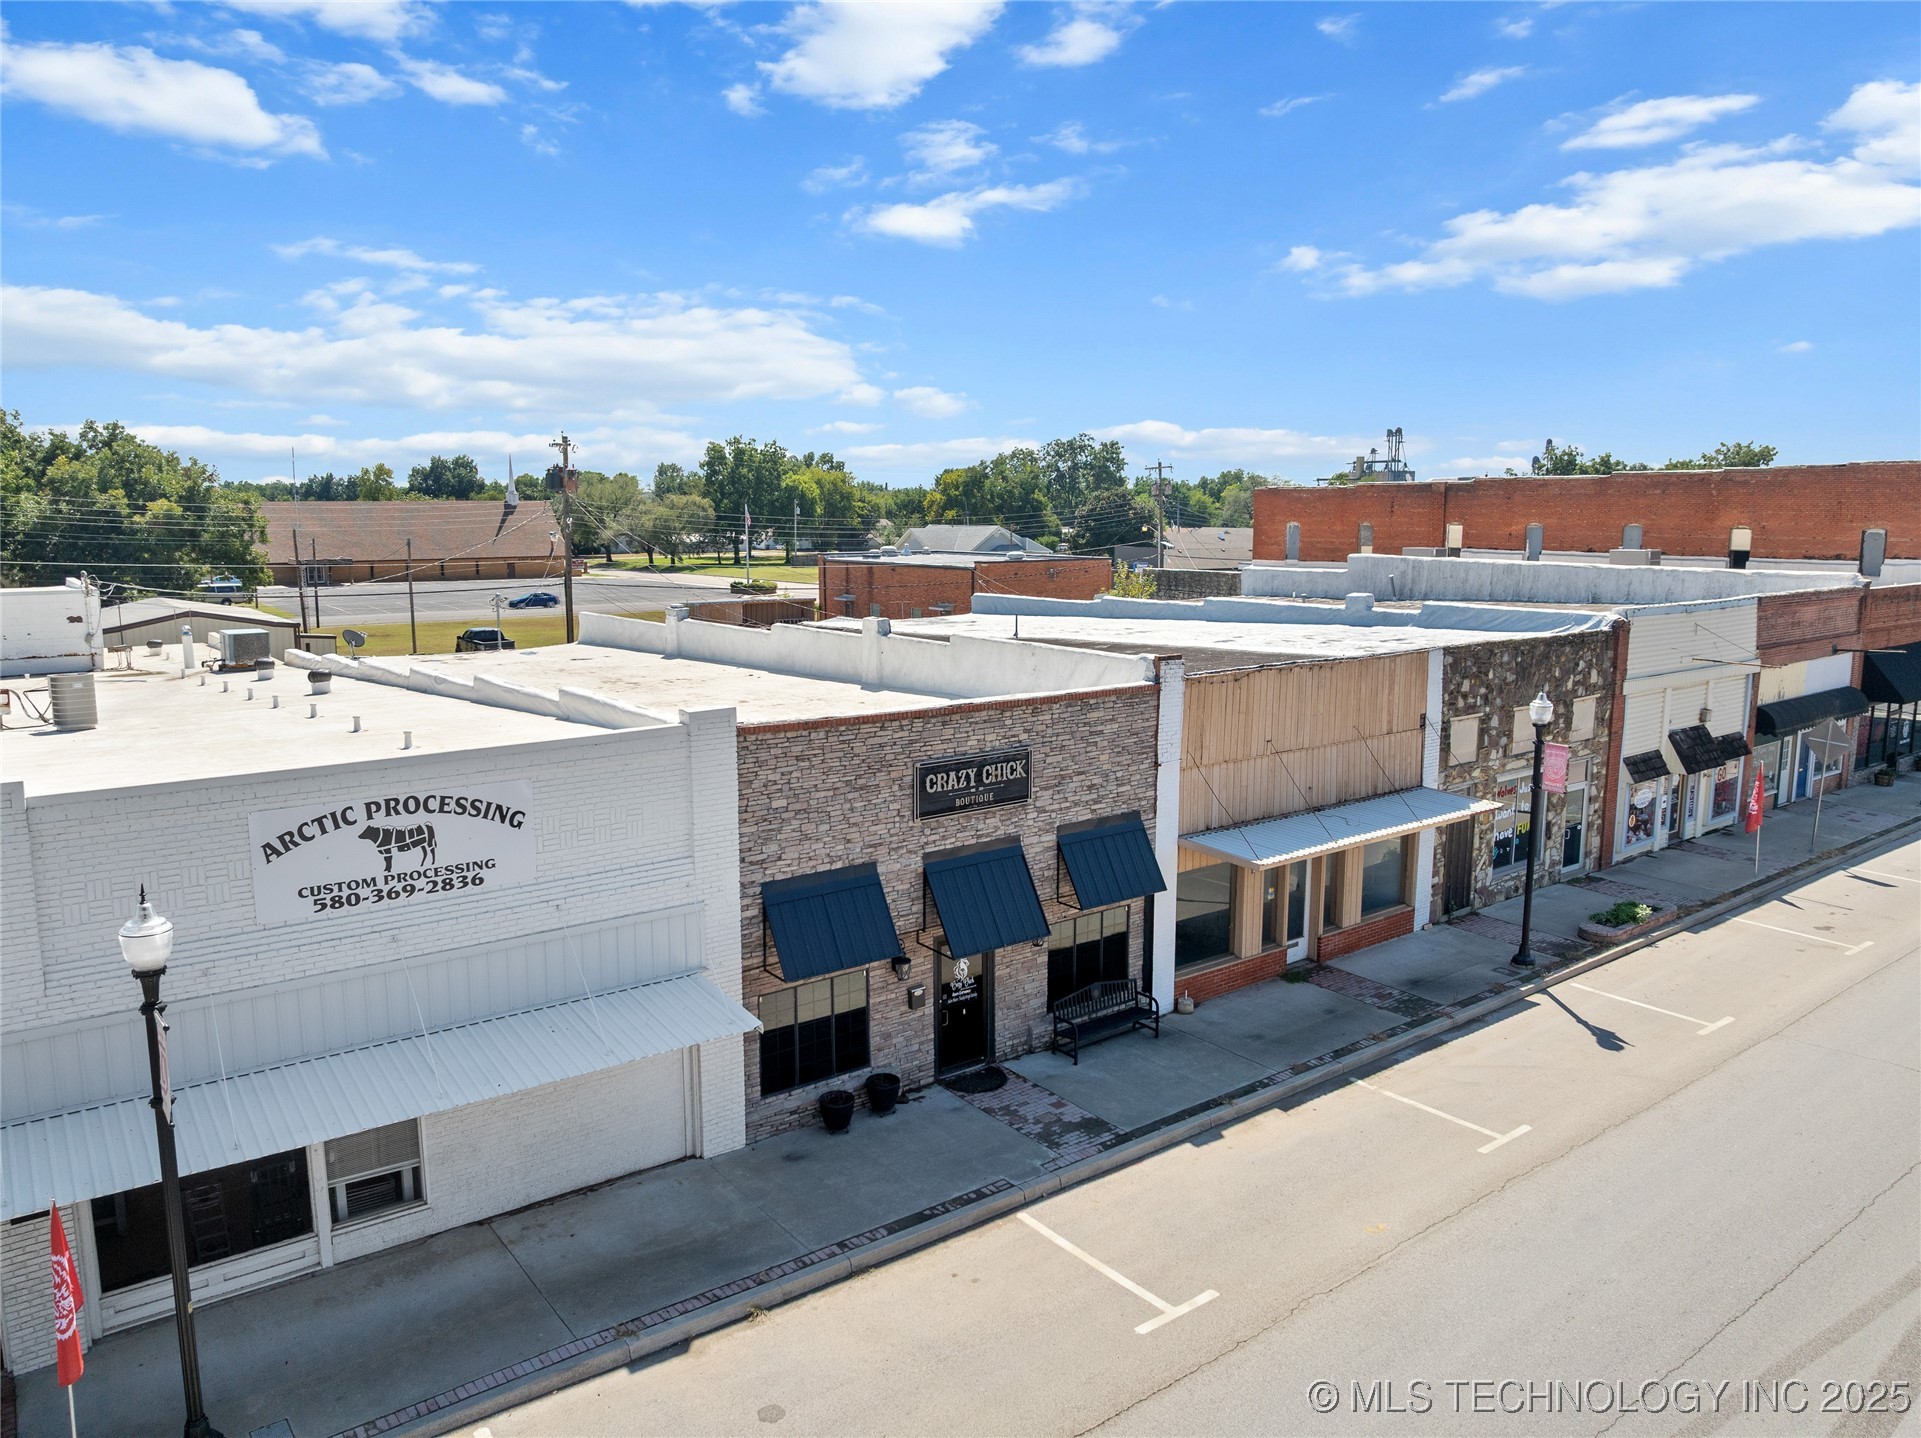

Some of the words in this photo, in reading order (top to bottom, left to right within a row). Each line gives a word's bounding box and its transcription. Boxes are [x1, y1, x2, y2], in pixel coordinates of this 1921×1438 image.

[925, 767, 978, 793] CRAZY
[982, 759, 1027, 784] CHICK
[955, 792, 994, 807] BOUTIQUE
[260, 805, 358, 865] ARCTIC
[364, 794, 526, 831] PROCESSING
[1494, 827, 1513, 842] have
[297, 876, 378, 899] CUSTOM
[383, 858, 497, 886] PROCESSING
[312, 871, 486, 914] 580-369-2836
